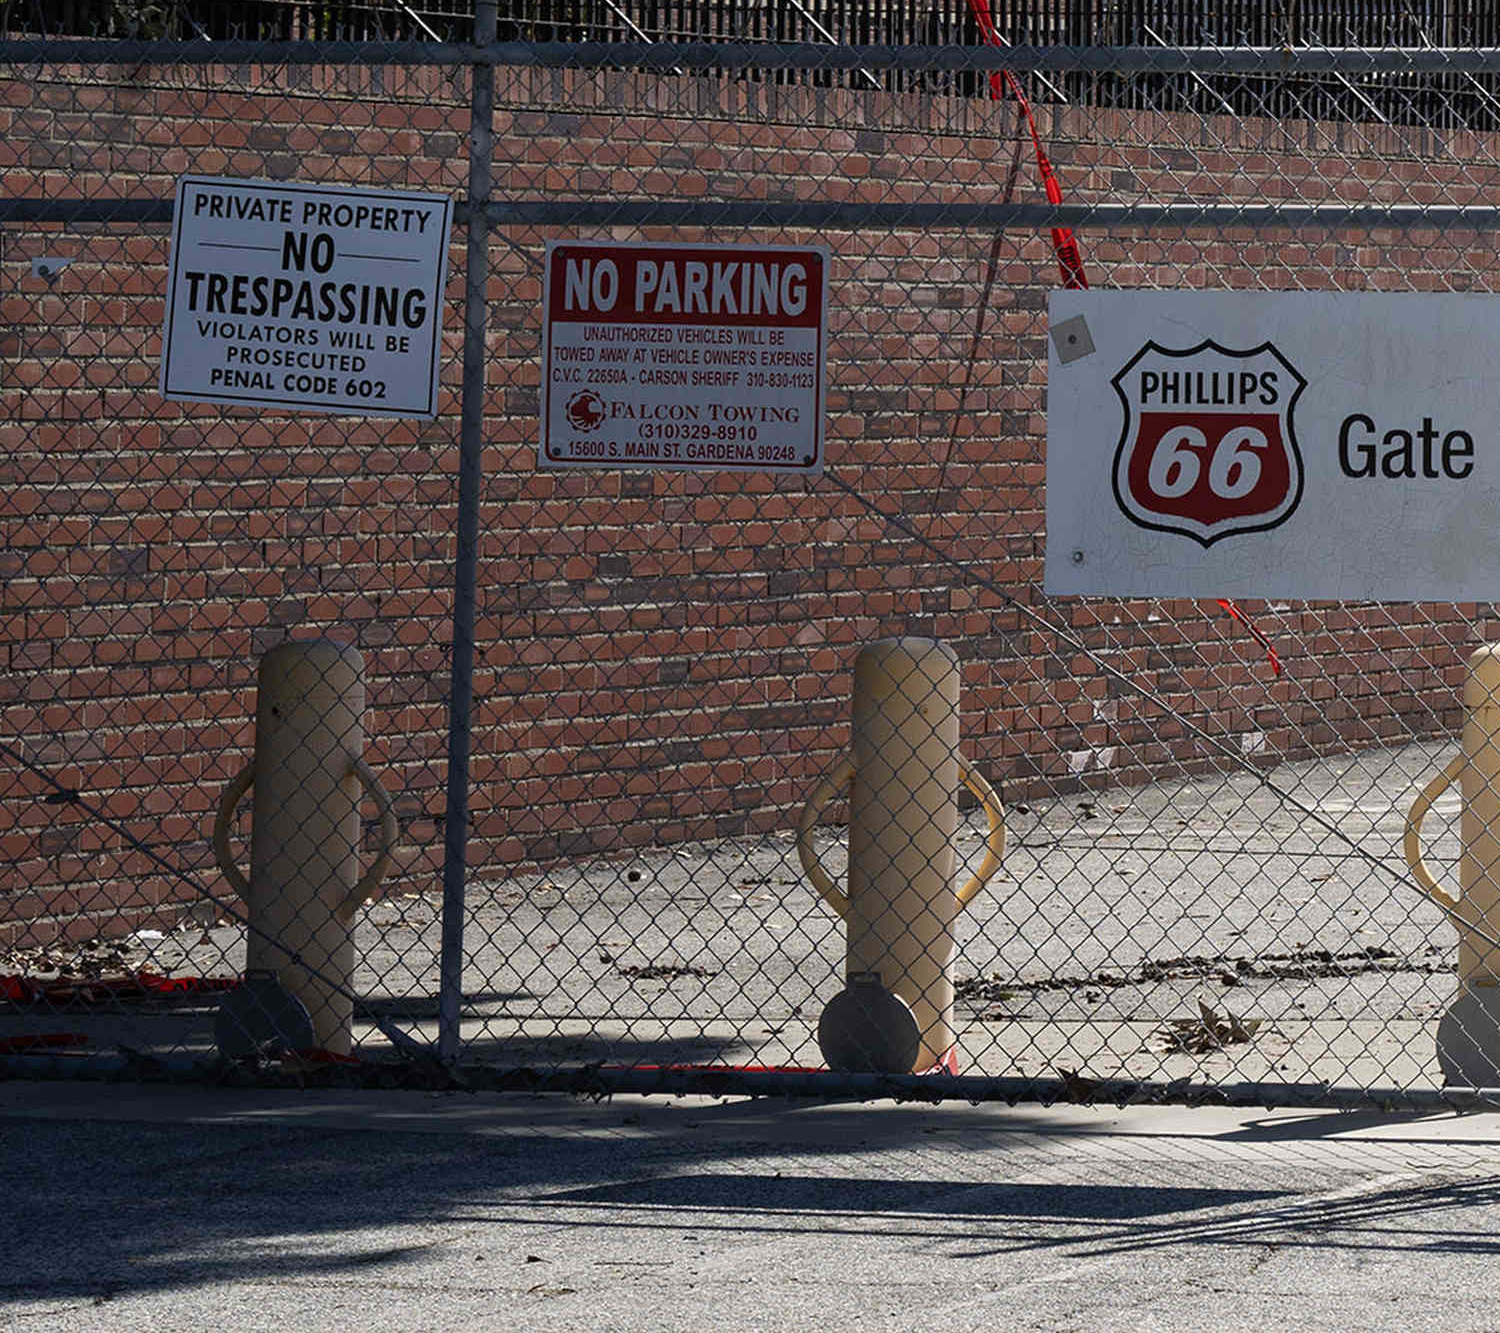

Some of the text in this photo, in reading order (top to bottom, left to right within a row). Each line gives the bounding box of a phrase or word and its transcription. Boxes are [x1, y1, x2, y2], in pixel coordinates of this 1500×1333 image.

[194, 193, 431, 233] PRIVATE PROPERTY
[281, 230, 334, 273] NO
[185, 271, 426, 329] TRESPASSING
[564, 258, 807, 316] NO PARKING
[196, 319, 409, 353] VIOLATORS WILL BE
[583, 326, 784, 345] UNAUTHORIZED VEHICLES WILL BE
[226, 345, 365, 372] PROSECUTED
[554, 346, 814, 367] TOWED AWAY AT VEHICLE OWNER'S EXPENSE
[210, 368, 385, 398] PENAL CODE 602
[552, 368, 583, 383] C.V.C.
[587, 368, 628, 383] 22650A
[638, 369, 687, 385] CARSON
[691, 370, 739, 386] SHERIFF
[746, 372, 814, 389] 310-830-1123
[1141, 371, 1278, 406] PHILLIPS
[638, 423, 757, 441] (310)329-8910
[1338, 413, 1475, 480] Gate
[569, 440, 795, 461] 15600 S. MAIN ST. GARDENA 90248
[1149, 425, 1268, 499] 66
